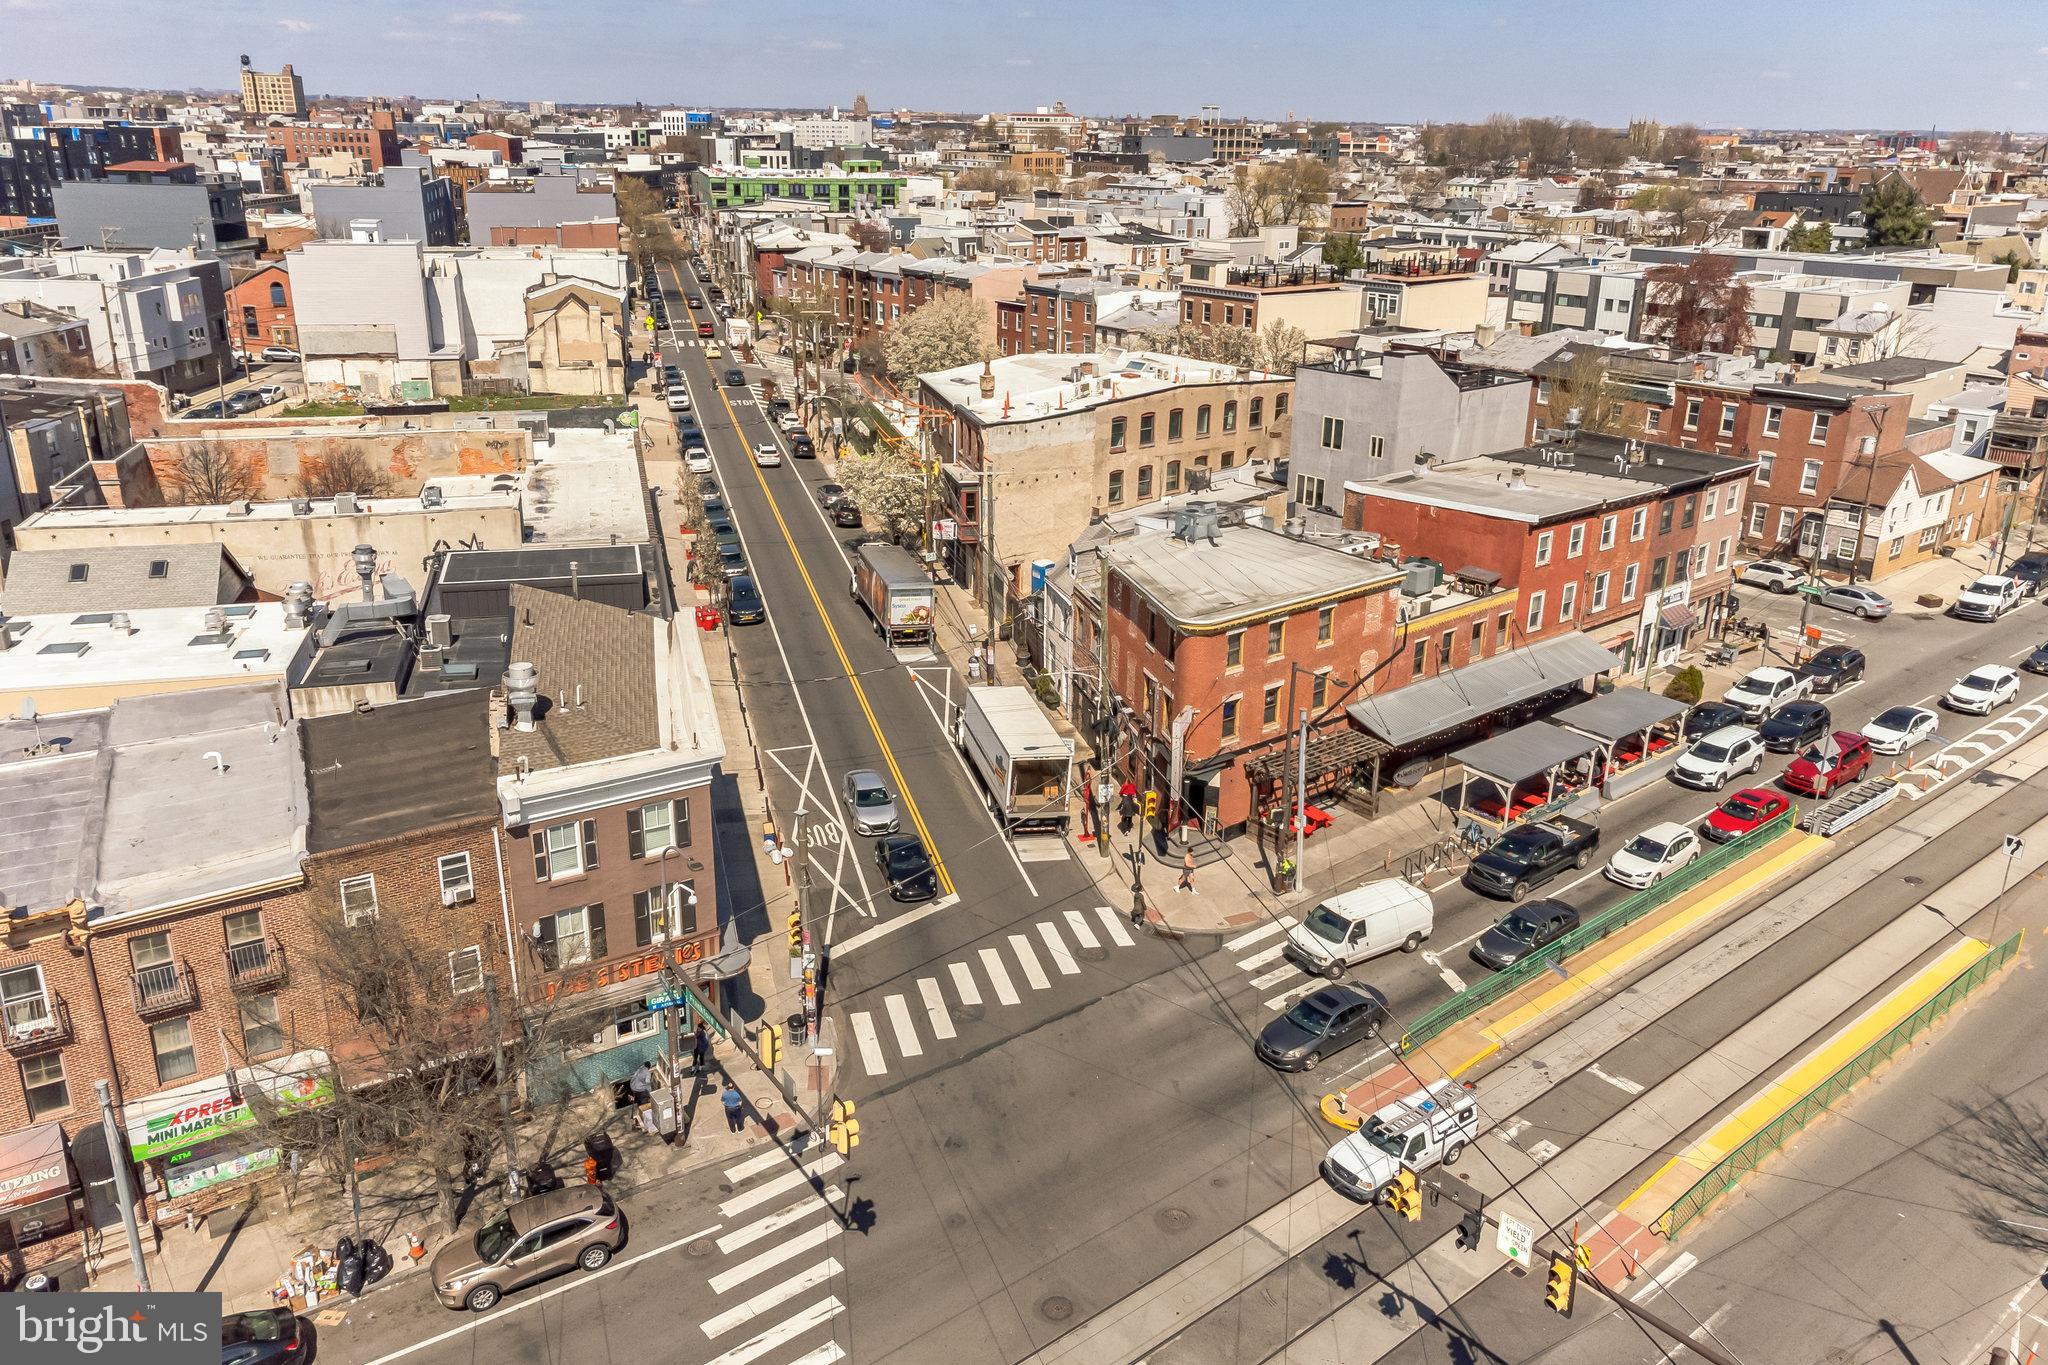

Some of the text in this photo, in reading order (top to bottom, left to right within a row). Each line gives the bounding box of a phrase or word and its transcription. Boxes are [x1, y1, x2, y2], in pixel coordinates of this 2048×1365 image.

[730, 399, 756, 407] STOP
[806, 822, 840, 848] BUS
[651, 993, 681, 1005] GIRA
[147, 1126, 178, 1146] MINI
[181, 1109, 238, 1136] MARKET
[170, 1151, 193, 1164] ATM
[1506, 1226, 1525, 1242] YIELD
